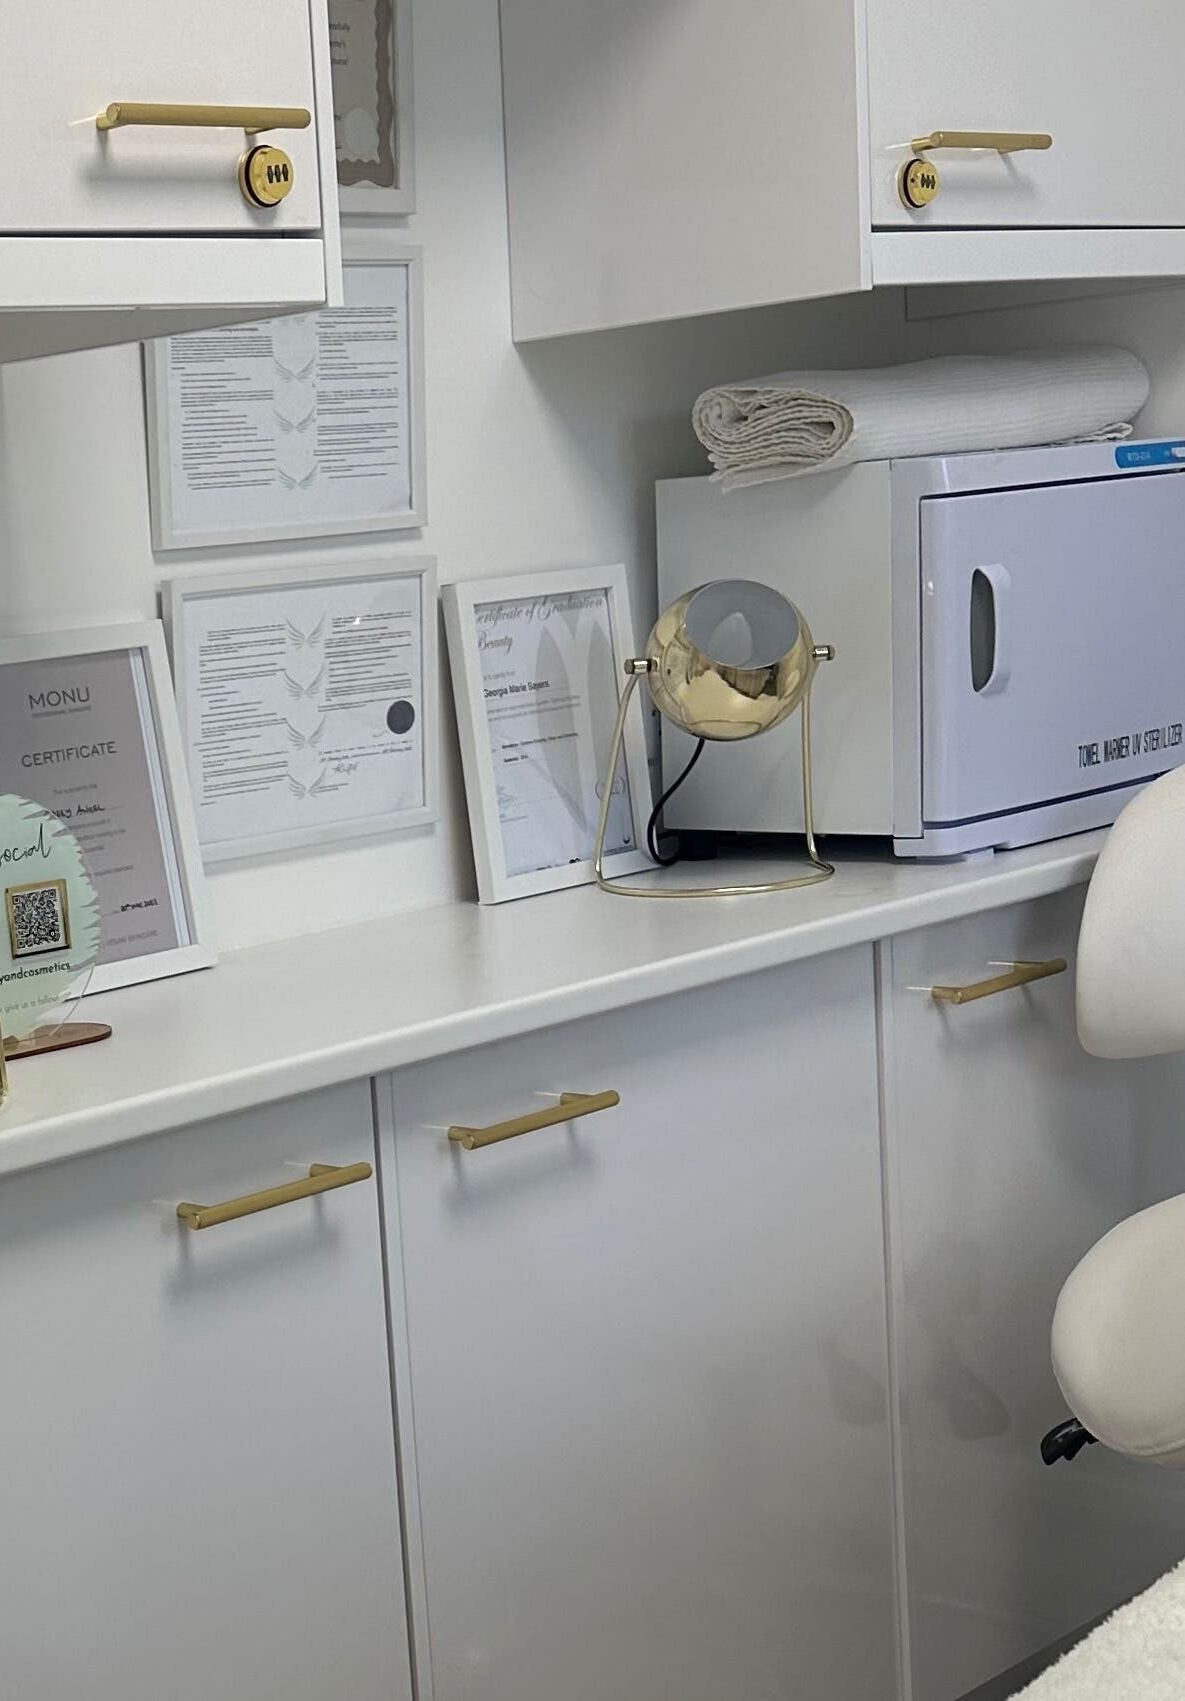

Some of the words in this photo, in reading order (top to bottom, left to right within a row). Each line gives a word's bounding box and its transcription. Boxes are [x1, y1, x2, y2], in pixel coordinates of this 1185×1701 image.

[477, 604, 524, 627] ertificate
[28, 686, 90, 709] MONU
[21, 741, 117, 767] CERTIFICATE
[1078, 743, 1100, 768] TOWEL
[1104, 736, 1130, 762] WARMER
[1132, 733, 1142, 756] UV
